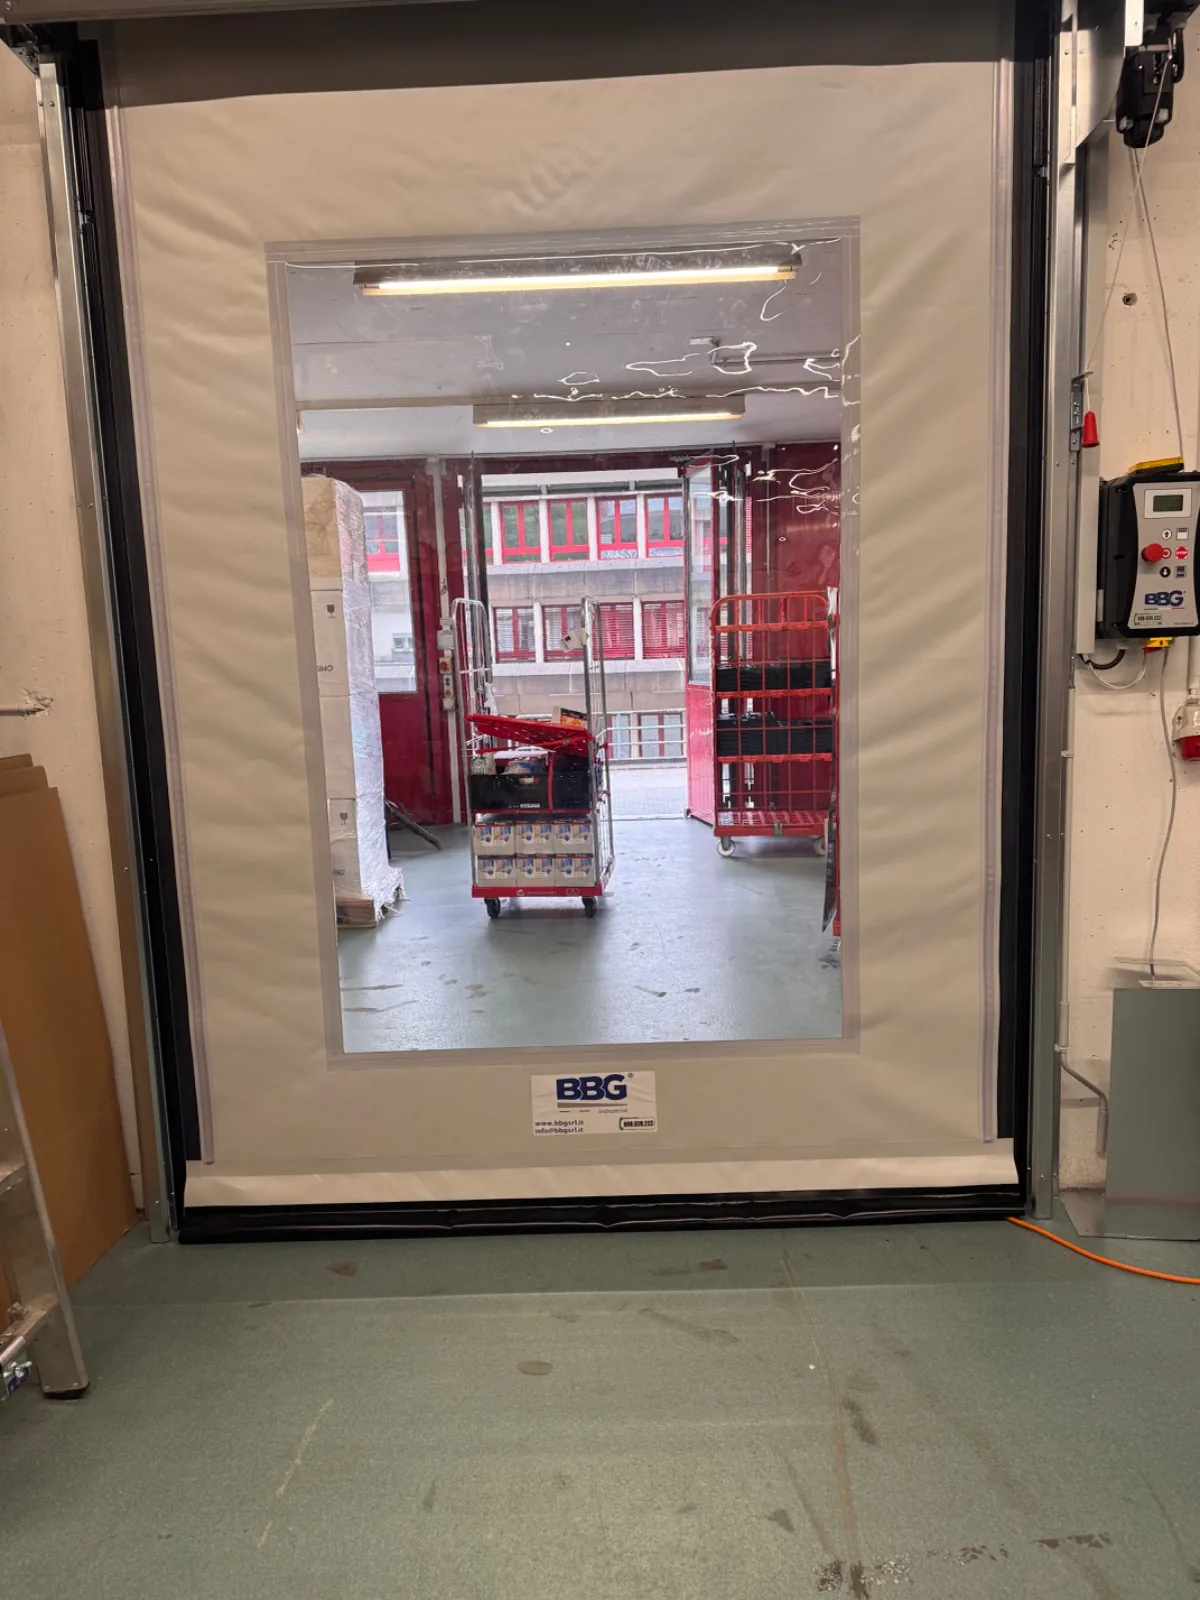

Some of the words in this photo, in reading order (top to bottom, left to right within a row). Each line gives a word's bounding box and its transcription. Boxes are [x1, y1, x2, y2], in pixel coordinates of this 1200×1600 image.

[1144, 590, 1183, 606] BBG
[556, 1074, 627, 1100] BBG
[535, 1119, 584, 1127] www.bbgsrl.it
